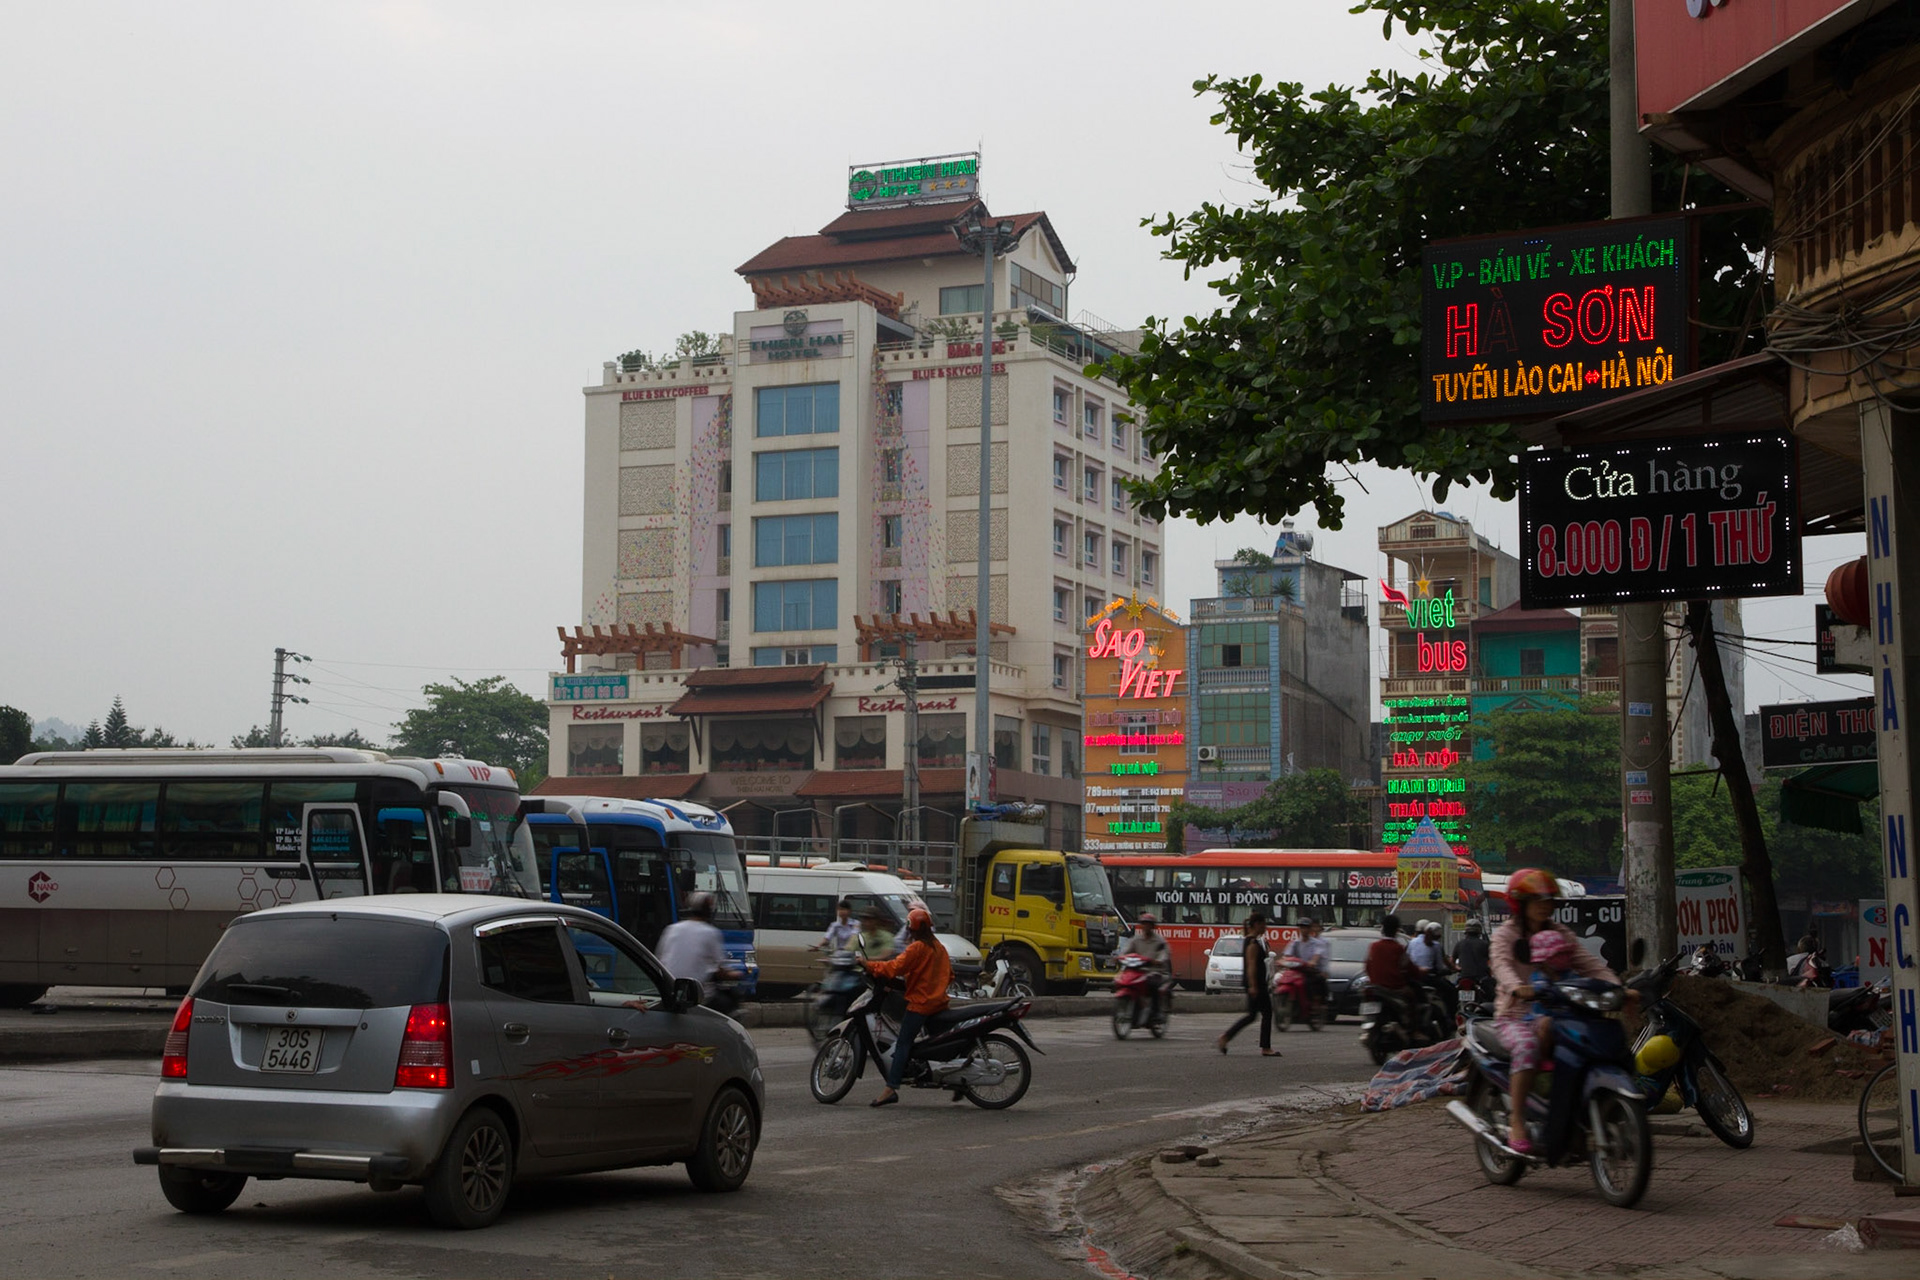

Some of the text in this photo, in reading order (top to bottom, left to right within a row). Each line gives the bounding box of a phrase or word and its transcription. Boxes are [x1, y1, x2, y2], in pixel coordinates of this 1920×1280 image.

[941, 158, 977, 177] HAI
[879, 184, 921, 197] HOTEL
[1479, 248, 1521, 286] BÁN
[1569, 247, 1596, 277] XE
[1602, 234, 1675, 273] KHÁCH
[1542, 284, 1654, 348] SƠN
[808, 334, 844, 347] HAI
[768, 348, 823, 361] HOTEL
[912, 368, 936, 380] BLUE
[1432, 363, 1498, 403] TUYẾN
[1503, 360, 1544, 398] LÀO
[1548, 362, 1583, 393] CAI
[1601, 350, 1631, 389] HÀ
[622, 390, 644, 401] BLUE
[1564, 458, 1743, 501] Cửa hàng
[1537, 518, 1622, 578] 8.000
[1708, 491, 1777, 566] THỨ
[1088, 618, 1145, 658] SAO
[1417, 632, 1467, 673] bus
[1119, 658, 1183, 699] VIET
[572, 703, 664, 721] Restaurant
[858, 696, 957, 712] Restarant
[1769, 708, 1828, 742] ĐIỆN
[1389, 730, 1424, 745] CHẠY
[1392, 747, 1459, 770] HÀ NỘI
[1799, 742, 1845, 761] CẦM
[467, 766, 491, 781] VIP
[1127, 761, 1140, 774] HÀ
[1142, 760, 1159, 776] NỘI
[730, 774, 791, 786] WELCOME TO
[1387, 778, 1424, 794] NAM
[1427, 777, 1466, 796] ĐỊNH
[1388, 799, 1425, 818] THÁI
[1084, 839, 1100, 850] 333
[37, 883, 59, 891] NANO
[1347, 873, 1375, 888] SAO
[1377, 875, 1397, 888] VIE
[1155, 889, 1183, 904] NGÔI
[1218, 893, 1231, 904] DI
[1235, 890, 1269, 907] ĐỘNG
[1274, 889, 1299, 905] CỦA
[988, 905, 1010, 916] VTS
[1598, 901, 1622, 923] CŨ
[1676, 884, 1739, 936] ƠM PHỞ
[1198, 927, 1216, 939] HÀ
[278, 1029, 311, 1049] 30S
[268, 1049, 312, 1069] 5446
